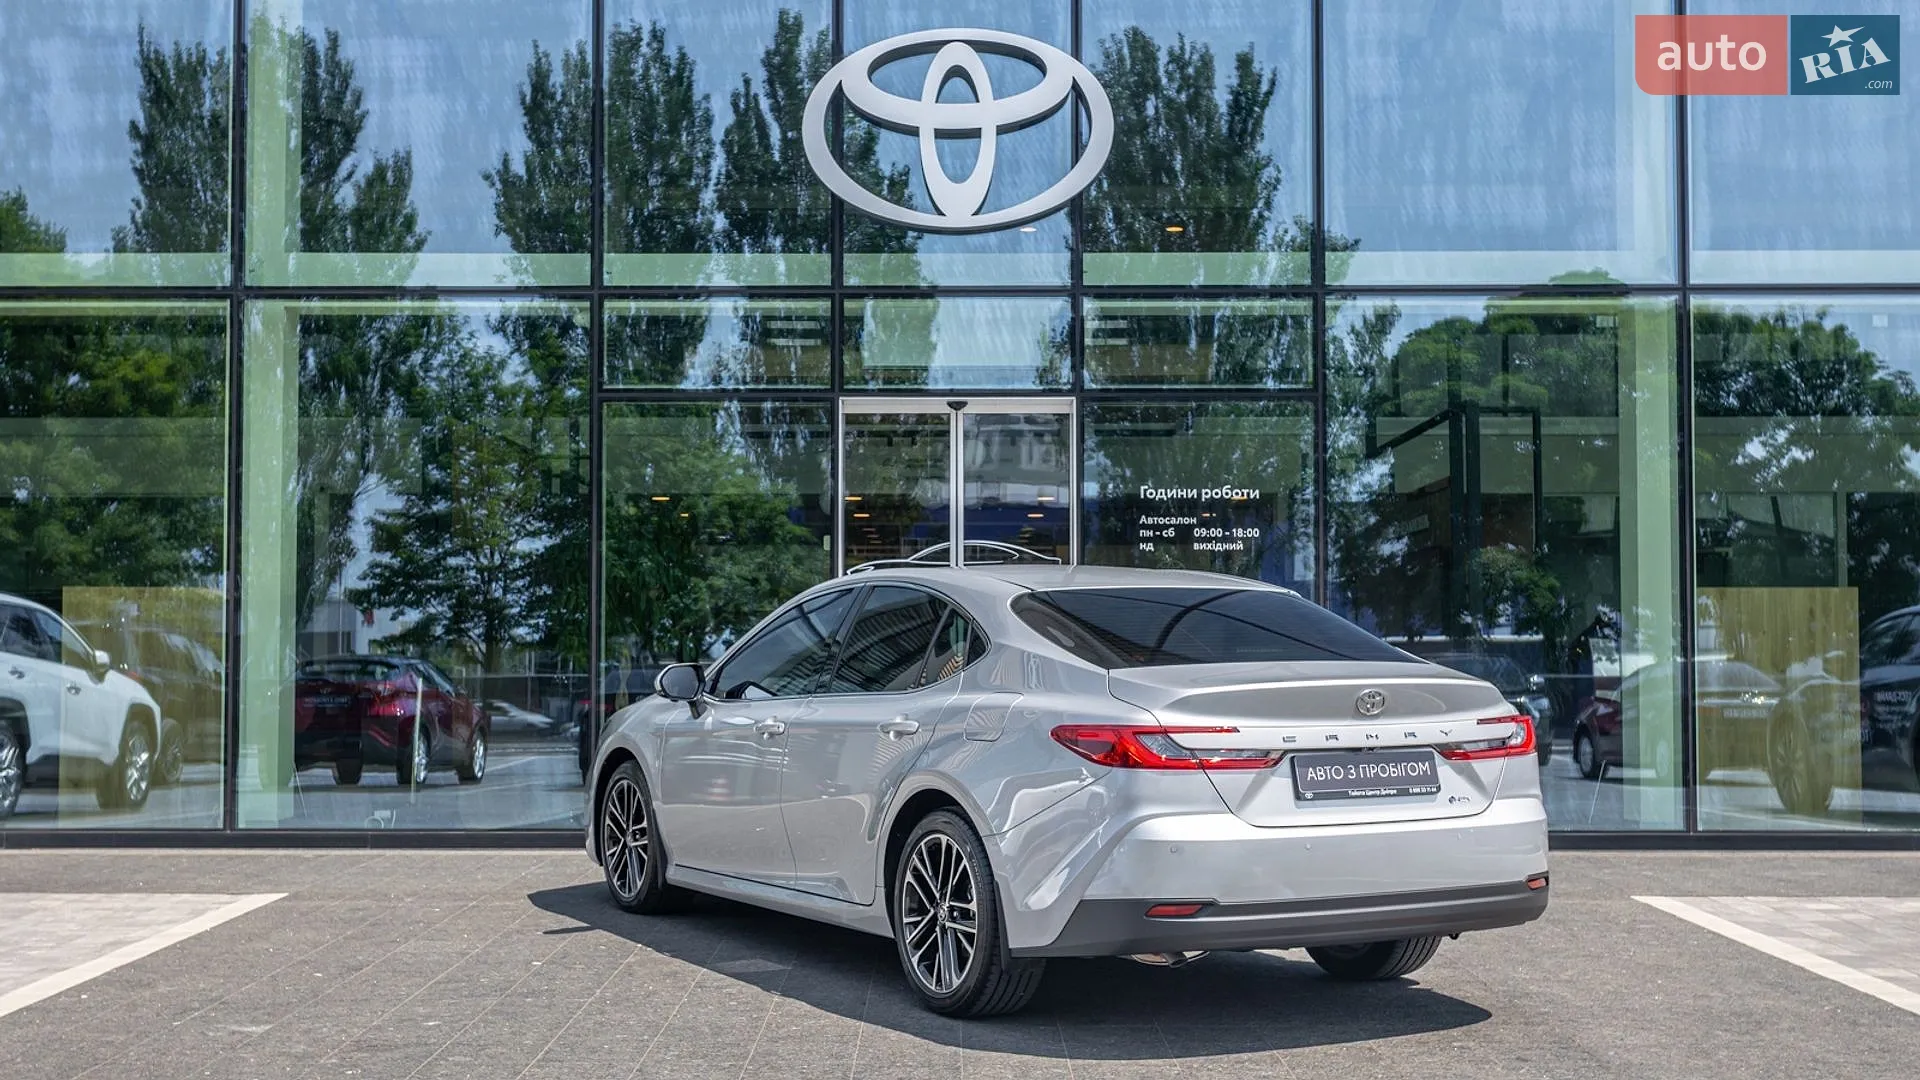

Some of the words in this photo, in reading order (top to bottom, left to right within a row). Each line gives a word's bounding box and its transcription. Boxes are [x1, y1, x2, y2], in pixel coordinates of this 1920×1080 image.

[1140, 486, 1197, 500] Години
[1202, 485, 1260, 501] роботи
[1139, 515, 1197, 525] Автосалон
[1140, 530, 1154, 538] пн
[1162, 528, 1175, 538] сб
[1193, 528, 1223, 538] 09:00
[1232, 528, 1260, 538] 18:00
[1140, 543, 1154, 552] нд
[1193, 541, 1244, 552] вихідний
[1307, 765, 1344, 781] АВТО
[1359, 761, 1431, 779] ПРОБІГОМ
